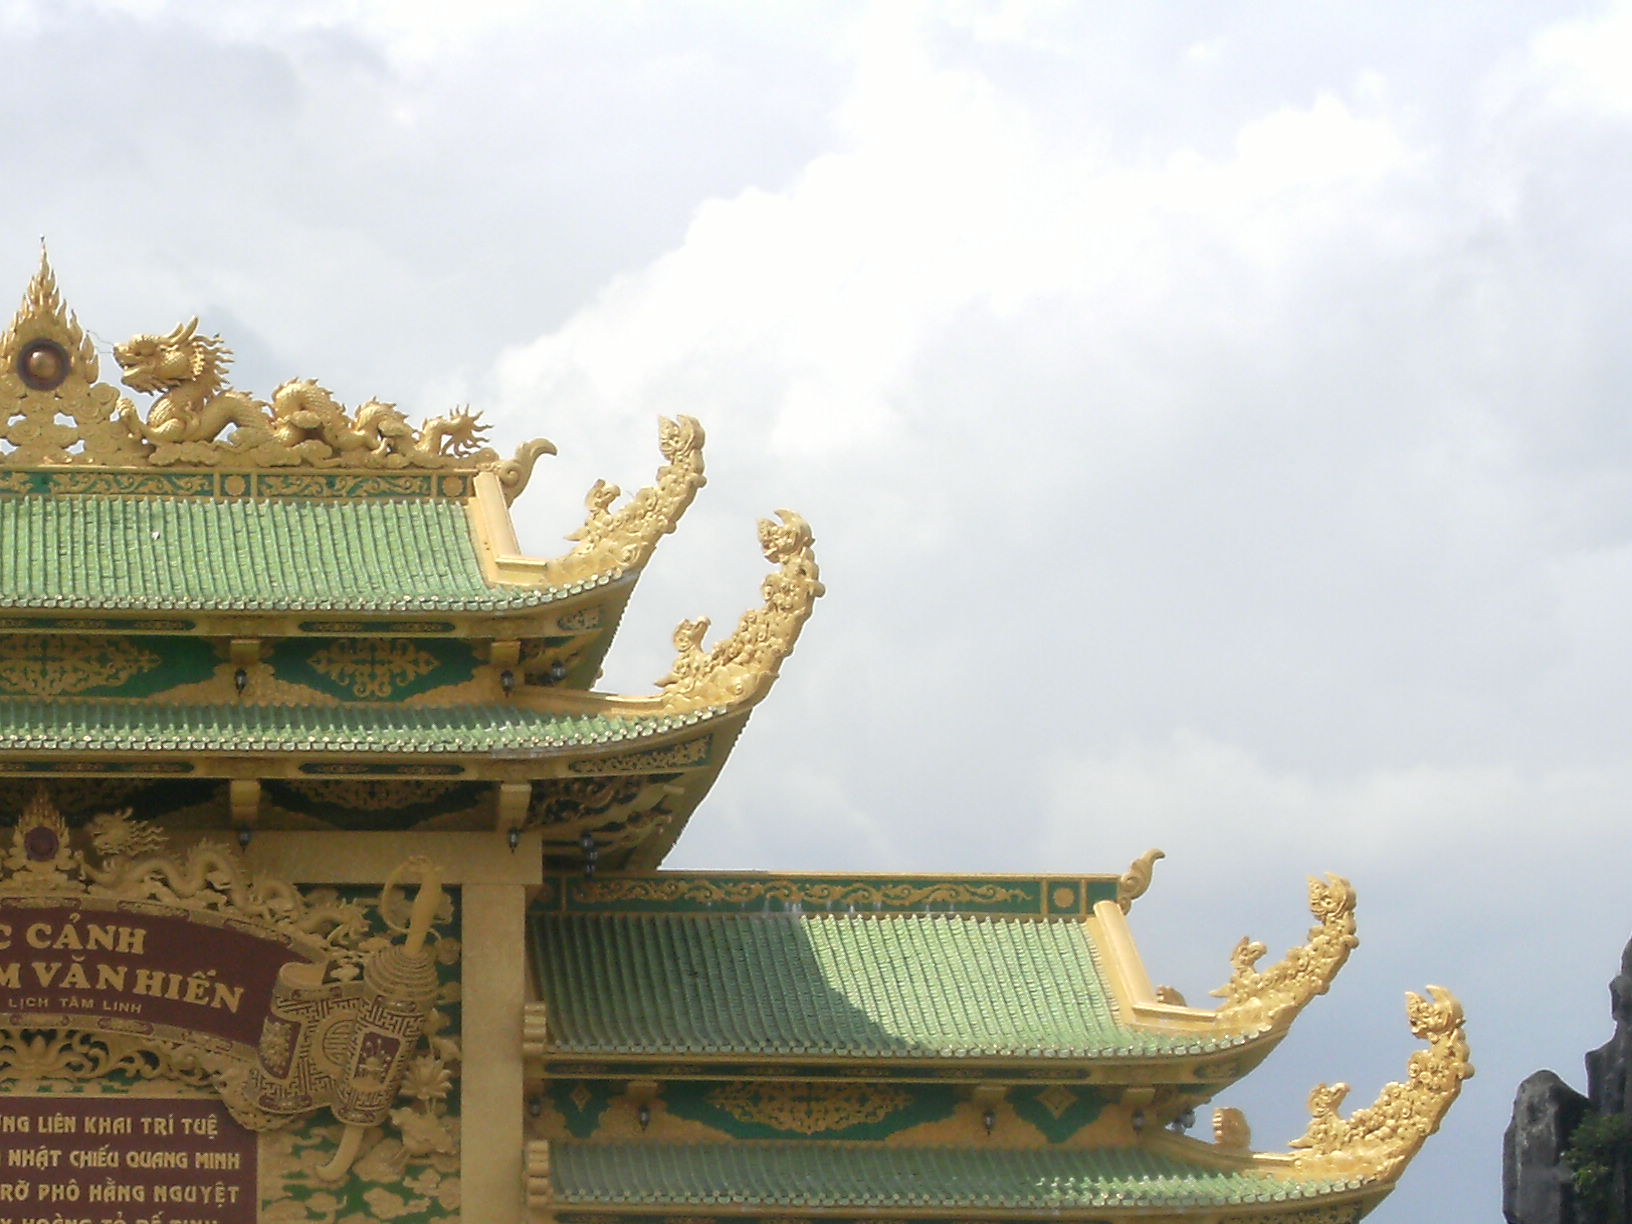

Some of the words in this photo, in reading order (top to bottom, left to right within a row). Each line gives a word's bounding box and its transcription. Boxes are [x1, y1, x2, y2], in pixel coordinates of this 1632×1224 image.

[26, 912, 147, 955] CẢNH
[31, 953, 128, 992] VĂN
[132, 969, 244, 1014] HIẾN
[8, 997, 48, 1010] LỊCH
[60, 995, 94, 1009] TÂM
[102, 1000, 142, 1014] LINH
[37, 1112, 76, 1133] LIÊN
[84, 1116, 132, 1136] KHAI
[140, 1113, 174, 1136] TRÍ
[180, 1113, 218, 1139] TUỆ
[8, 1145, 62, 1170] NHẬT
[69, 1143, 118, 1169] CHIẾU
[126, 1151, 188, 1169] QUANG
[195, 1152, 240, 1170] MINH
[0, 1179, 30, 1202] RỠ
[89, 1176, 145, 1203] HẰNG
[153, 1181, 239, 1209] NGUYỆT
